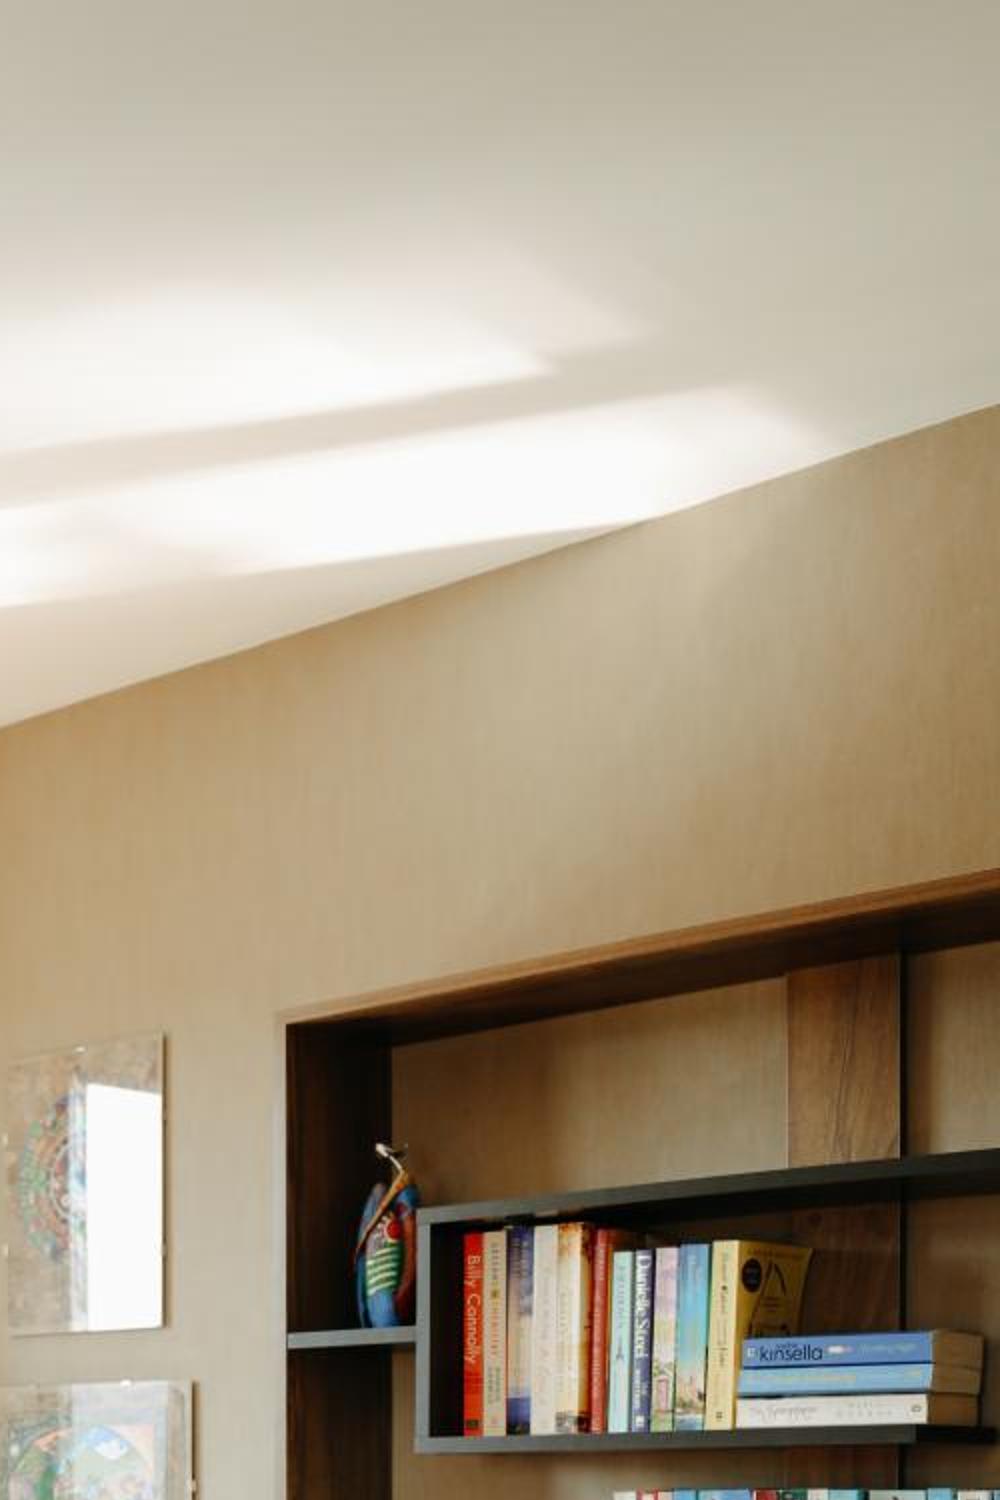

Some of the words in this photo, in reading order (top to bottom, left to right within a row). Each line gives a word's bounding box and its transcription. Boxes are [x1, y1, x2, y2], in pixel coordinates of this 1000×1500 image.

[467, 1255, 481, 1289] Billy
[635, 1254, 652, 1317] Danielle
[464, 1293, 481, 1365] Connolly
[635, 1317, 650, 1358] Steel
[759, 1343, 823, 1362] kinsella
